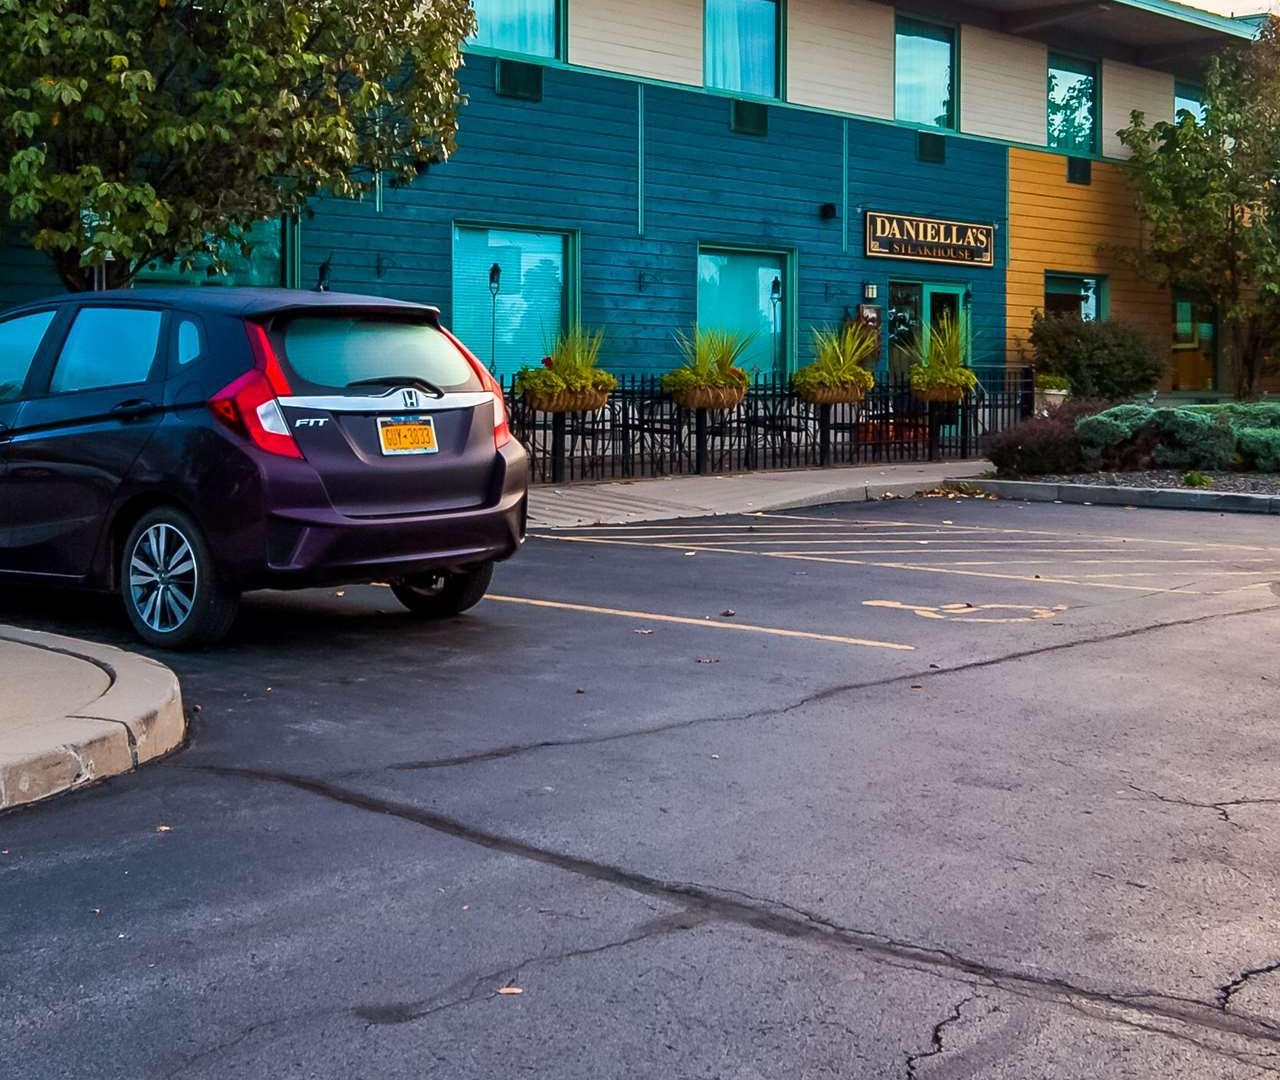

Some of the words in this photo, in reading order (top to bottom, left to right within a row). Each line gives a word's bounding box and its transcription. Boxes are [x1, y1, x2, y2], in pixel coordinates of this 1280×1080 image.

[875, 216, 987, 248] DANIELLA'S
[891, 242, 972, 260] STEAKHOUSE
[295, 418, 329, 427] FIT
